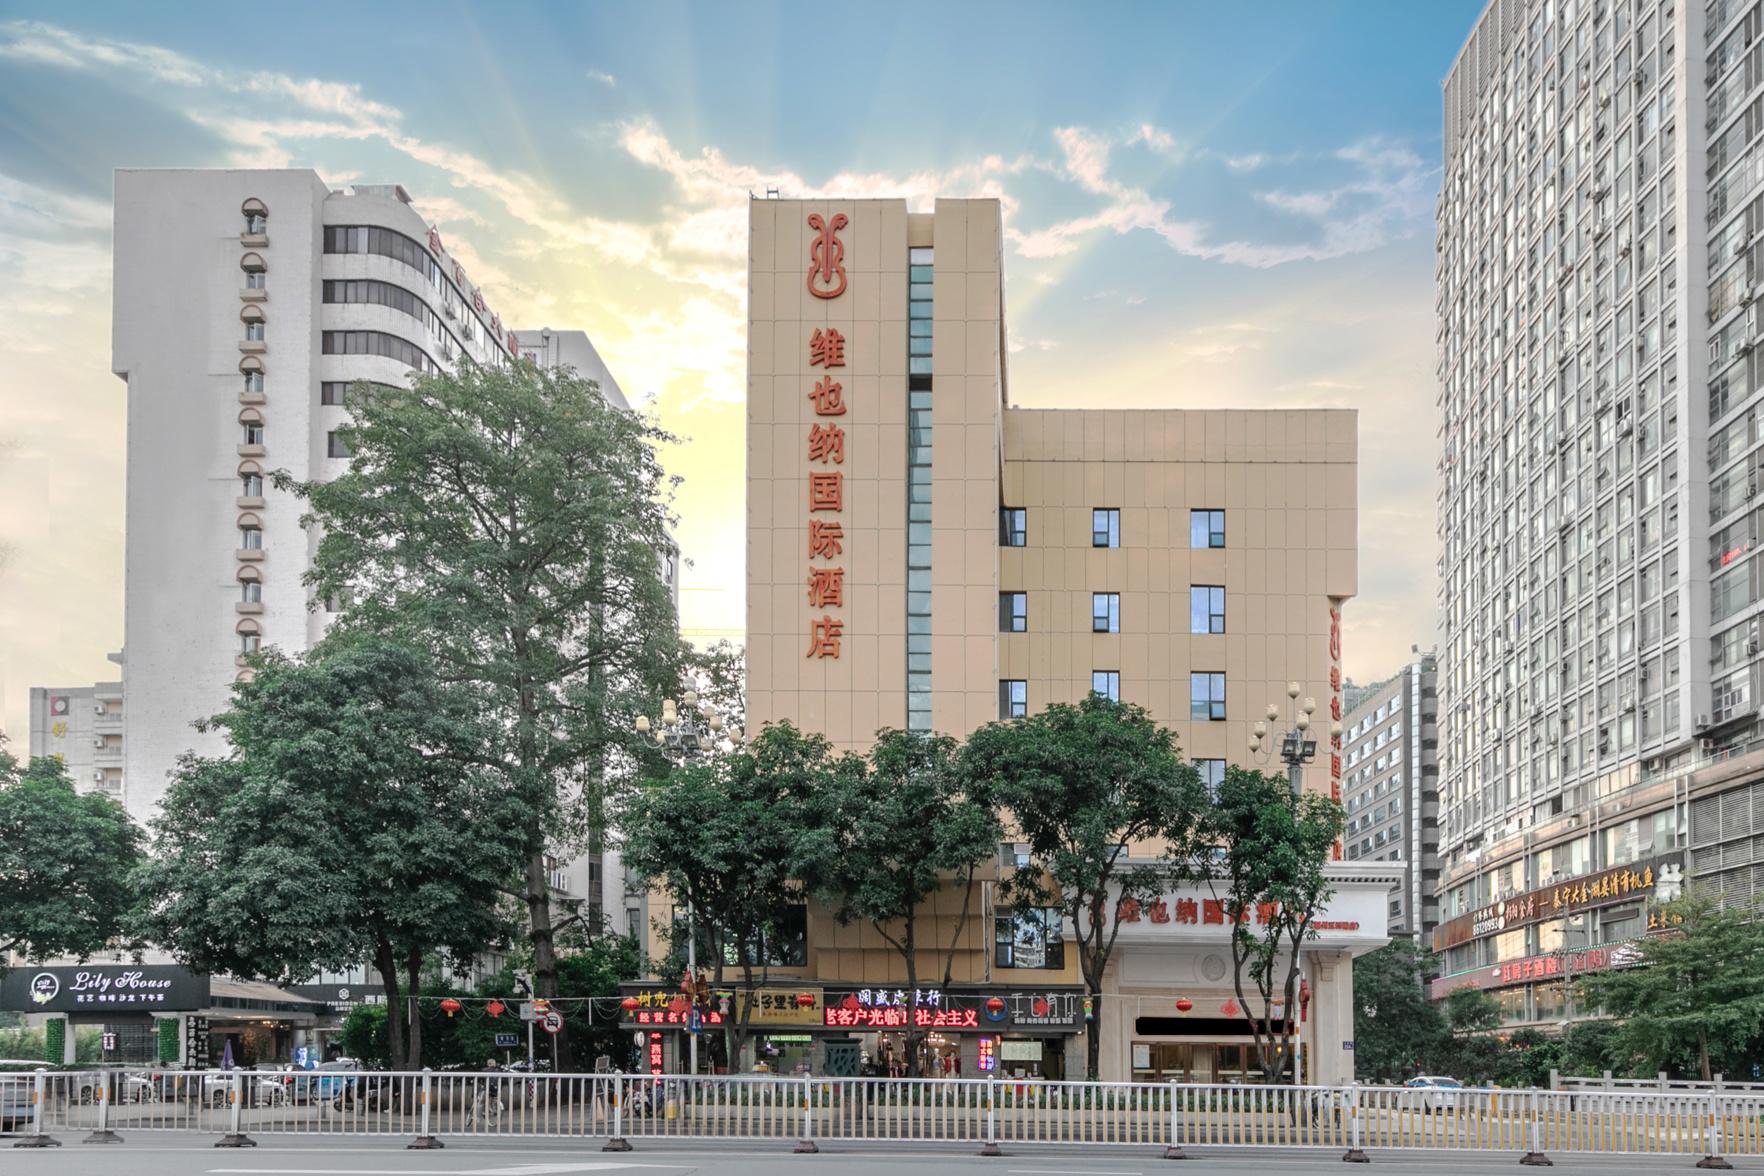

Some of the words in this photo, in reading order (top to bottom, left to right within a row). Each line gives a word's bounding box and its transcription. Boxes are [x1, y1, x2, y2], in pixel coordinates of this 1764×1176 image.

[807, 328, 846, 659] 维也纳国际酒店
[1118, 896, 1309, 925] 维也纳国酒
[69, 972, 111, 992] Lily
[115, 971, 172, 990] House
